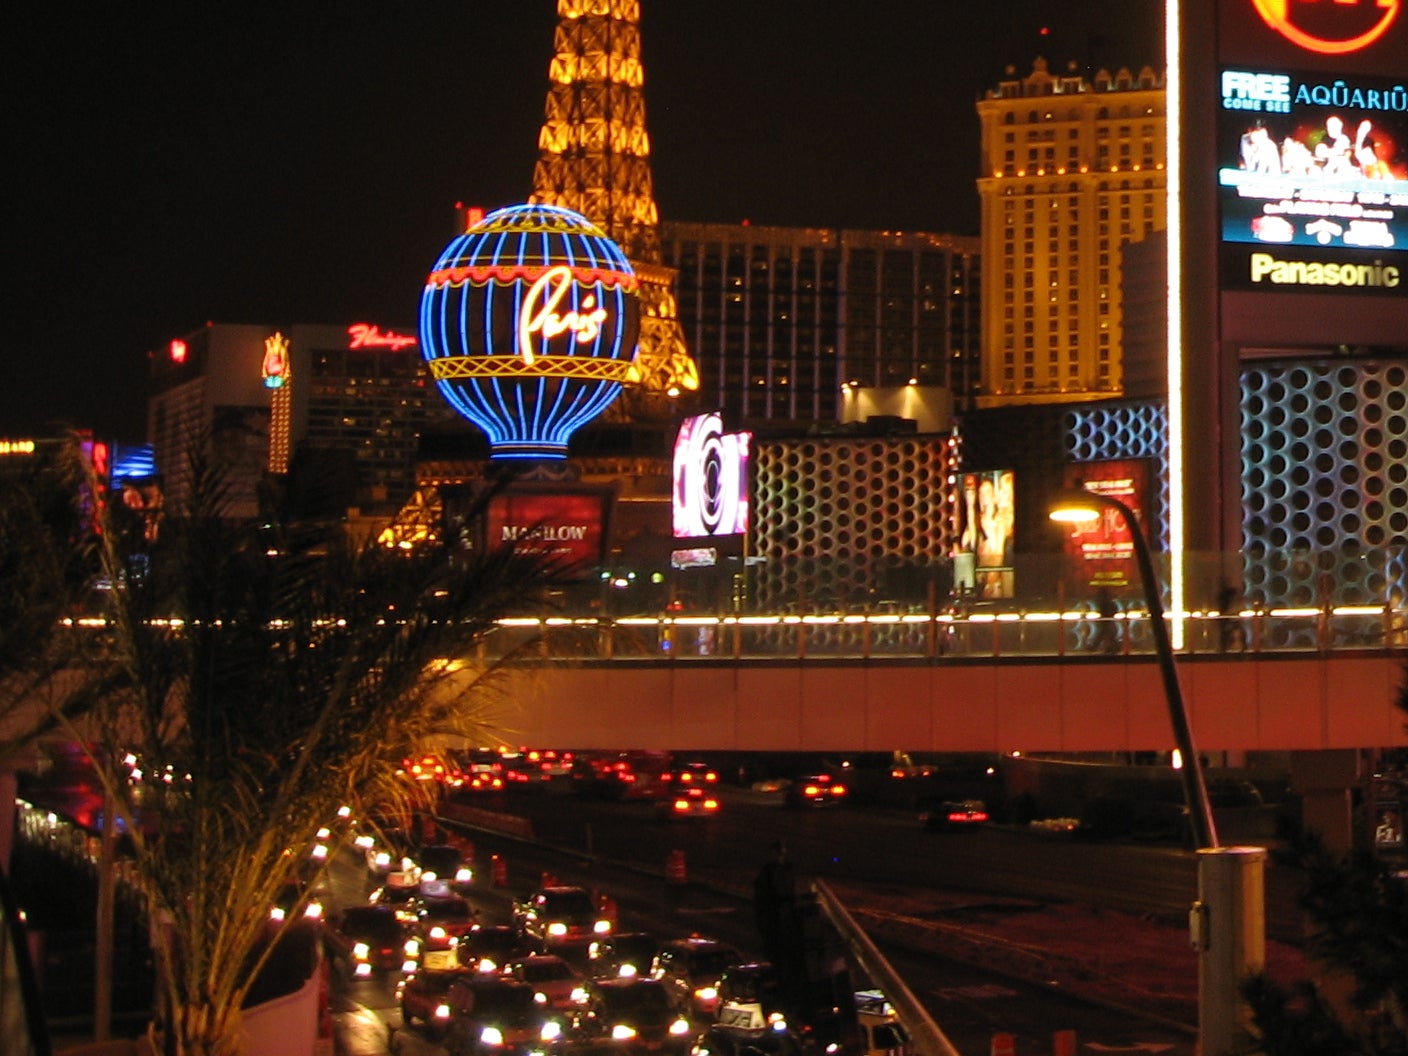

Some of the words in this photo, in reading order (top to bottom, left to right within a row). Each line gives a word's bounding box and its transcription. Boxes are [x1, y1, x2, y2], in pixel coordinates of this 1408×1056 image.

[1222, 71, 1290, 101] FREE
[1223, 98, 1261, 112] COME
[1266, 101, 1291, 113] SEE
[1251, 253, 1400, 288] Panasonic
[521, 265, 608, 365] Paris
